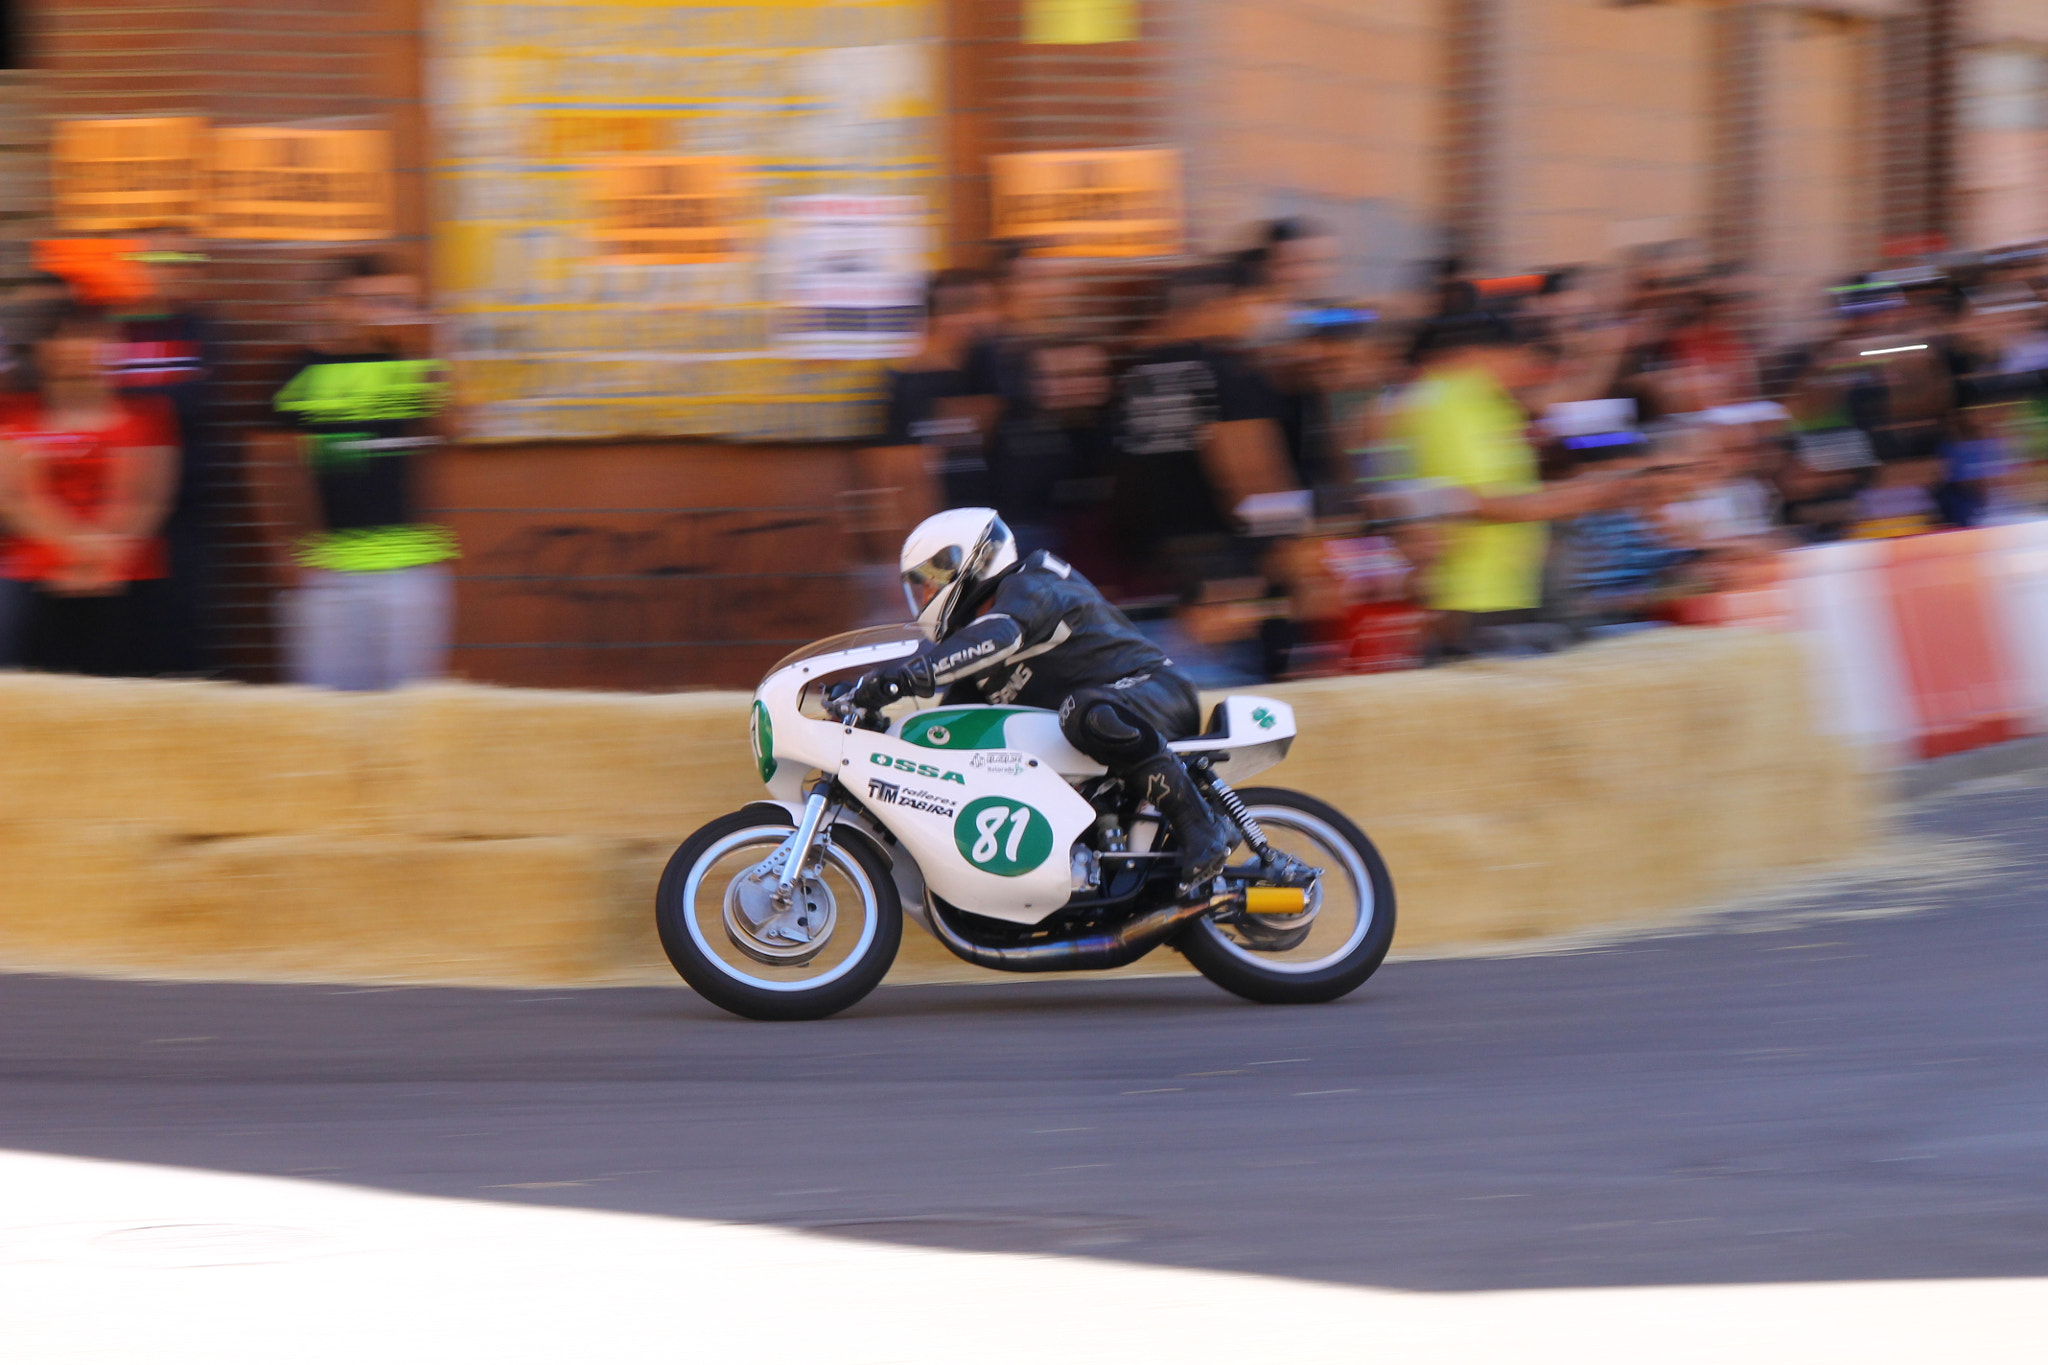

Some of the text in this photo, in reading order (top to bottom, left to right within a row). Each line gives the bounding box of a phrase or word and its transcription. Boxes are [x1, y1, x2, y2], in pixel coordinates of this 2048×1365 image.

[869, 752, 966, 786] OSSA
[868, 777, 900, 804] TTM
[898, 796, 955, 818] TABIRA
[971, 805, 1031, 864] 81
